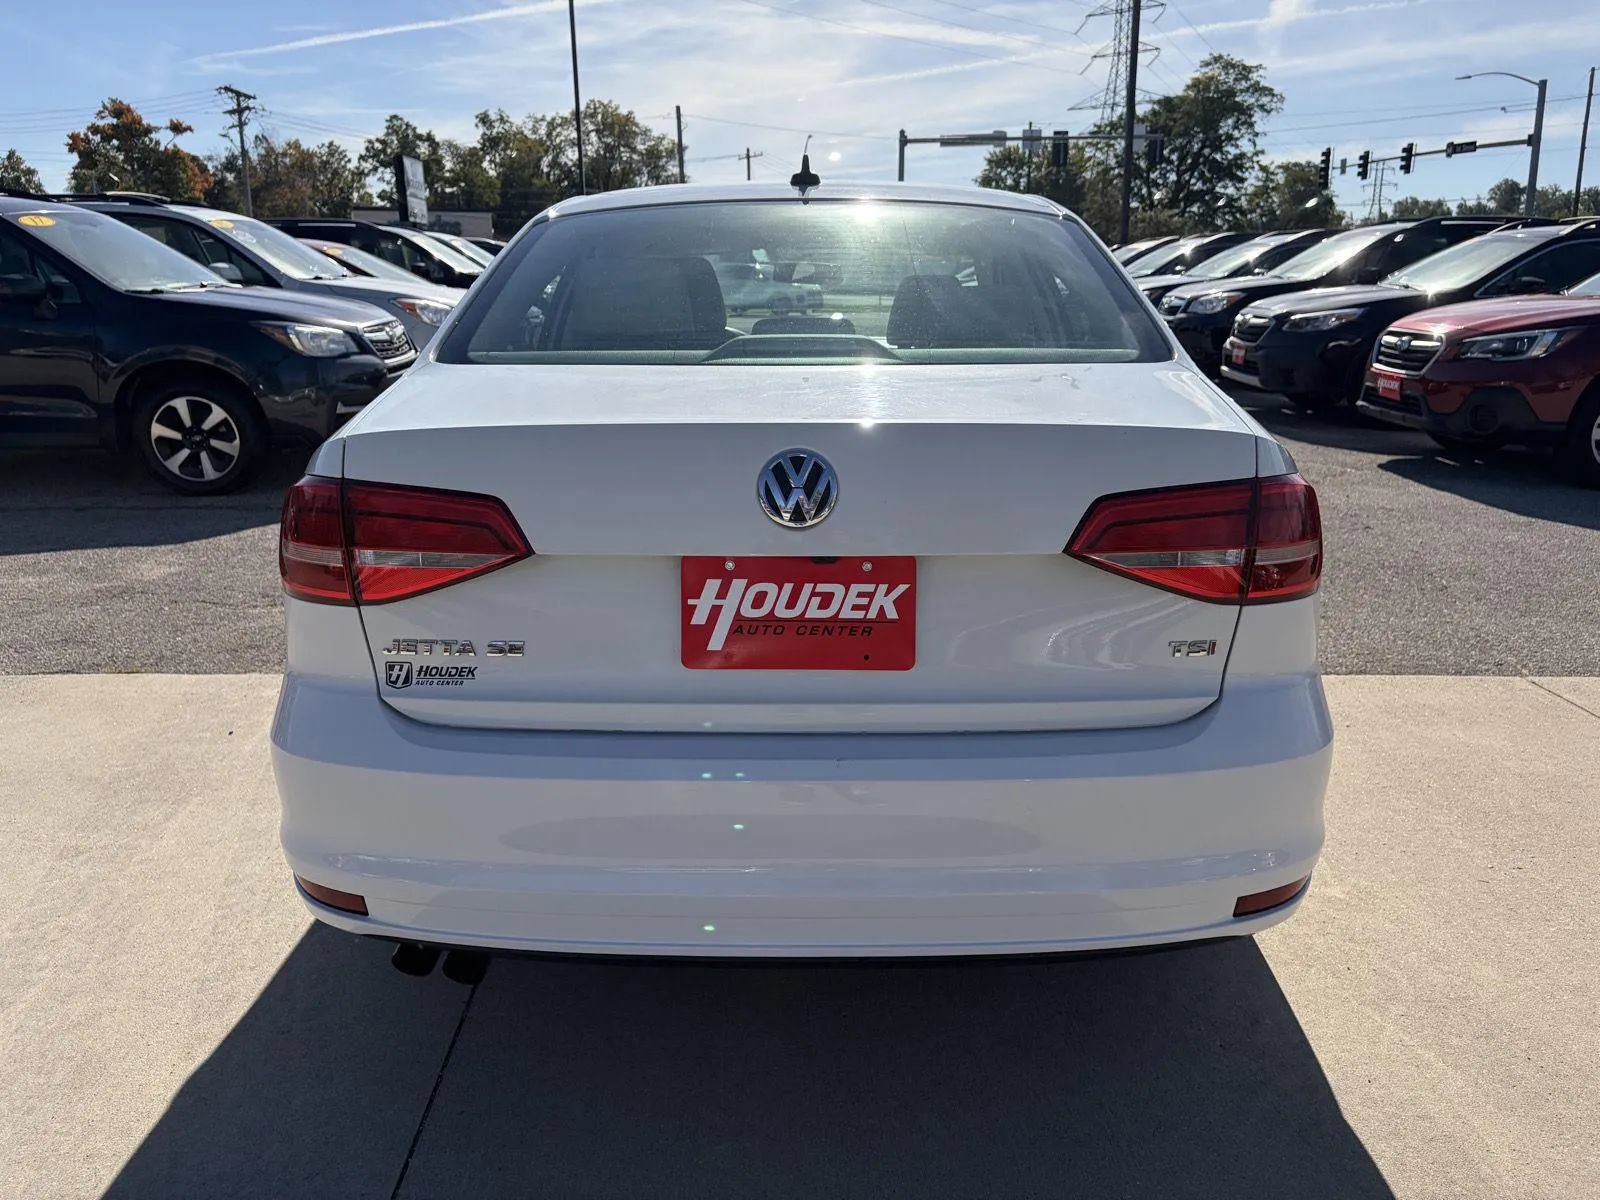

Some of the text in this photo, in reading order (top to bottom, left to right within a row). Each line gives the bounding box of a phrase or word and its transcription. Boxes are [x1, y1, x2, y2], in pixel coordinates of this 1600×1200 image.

[760, 449, 837, 526] VW
[687, 578, 911, 651] HOUDEK
[732, 624, 873, 637] AUTO CENTER
[382, 638, 526, 657] JETTA SE
[1168, 640, 1217, 658] TSI
[416, 665, 478, 678] HOUDEK
